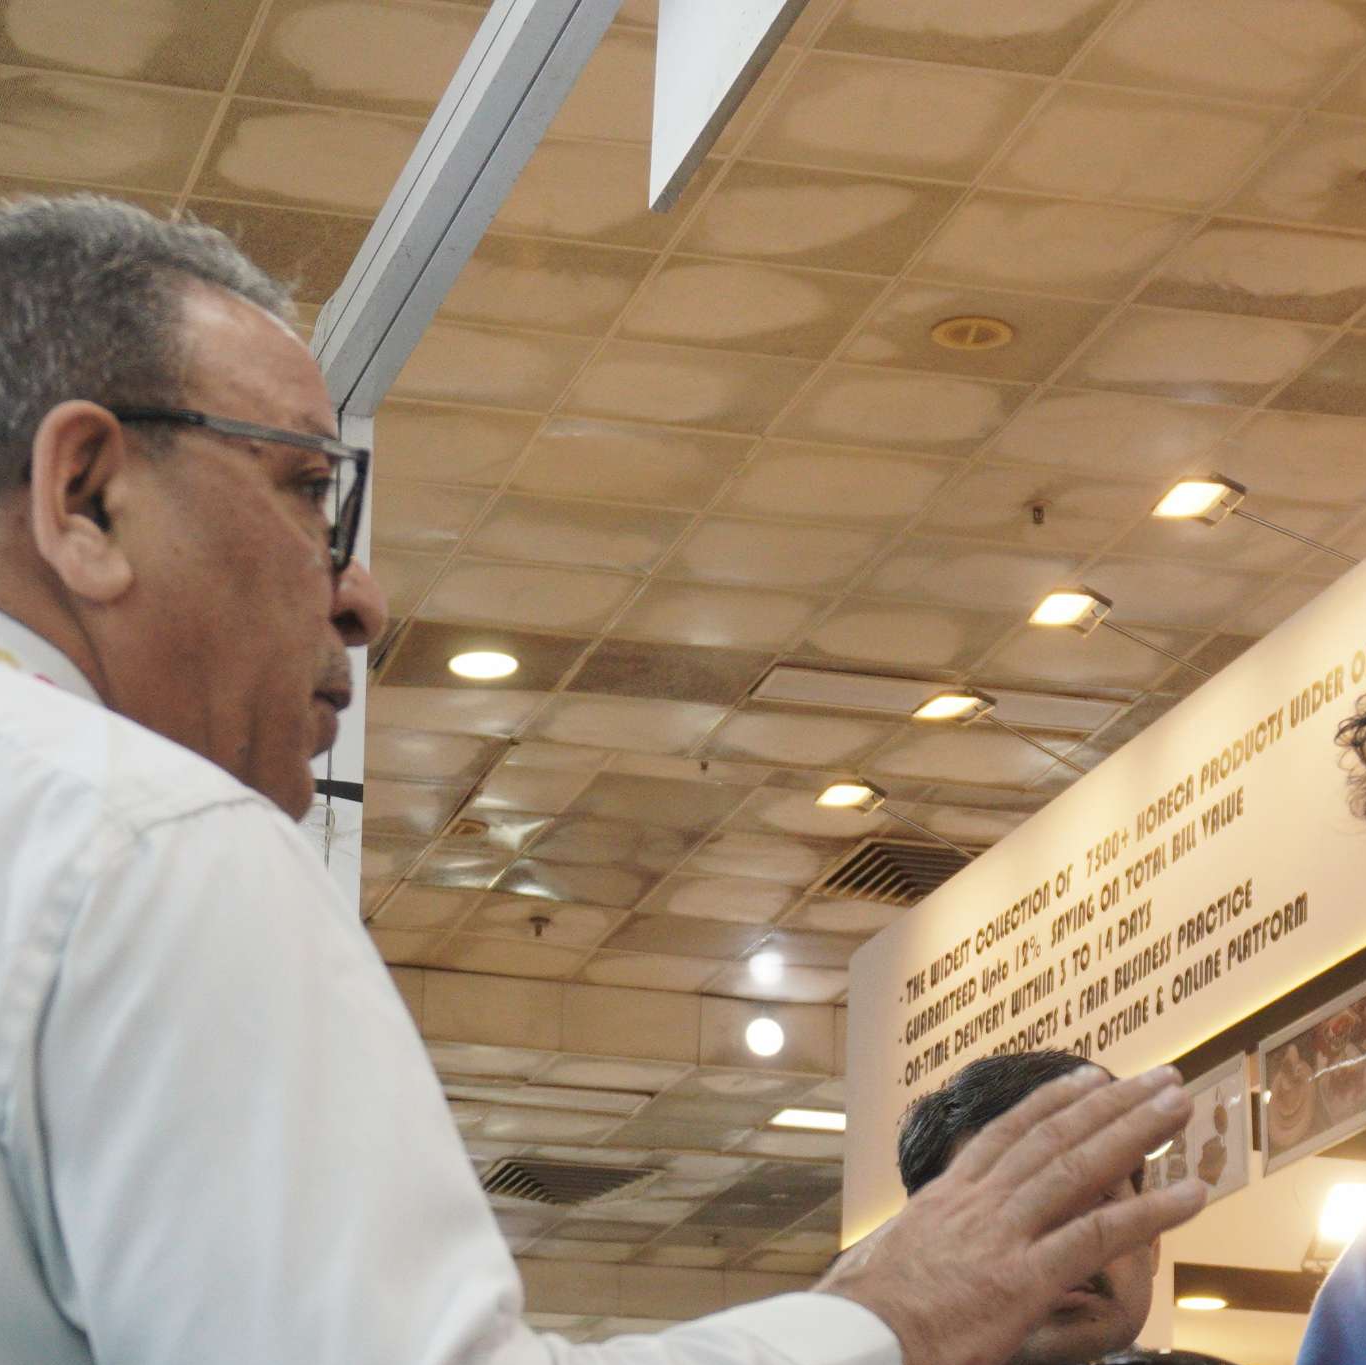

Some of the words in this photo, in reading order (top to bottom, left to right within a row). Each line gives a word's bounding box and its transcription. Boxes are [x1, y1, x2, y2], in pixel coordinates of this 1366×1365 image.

[905, 976, 977, 1045] GUARANTEED
[1051, 893, 1094, 948] SAVING
[1100, 876, 1120, 912] ON
[1125, 842, 1166, 895] TOTAL
[1172, 820, 1196, 864] BILL
[1201, 786, 1244, 839] VALUE
[906, 969, 926, 1004] THE
[930, 937, 971, 989] WIDEST
[975, 879, 1051, 955] COLLECTION
[1055, 864, 1073, 898] OF
[1086, 827, 1129, 878] 7500+
[1137, 773, 1194, 842] HORECA
[1200, 706, 1283, 795] PRODUCTS
[1290, 663, 1344, 728] UNDER
[905, 1036, 950, 1087] ON-TIME
[954, 997, 1006, 1056] DELIVERY
[1011, 966, 1054, 1019] WITHIN
[1072, 942, 1090, 977] TO
[1098, 926, 1113, 961] 14
[1118, 898, 1152, 948] DAYS
[1079, 975, 1109, 1019] FAIR
[1114, 930, 1172, 996] BUSINESS
[1177, 877, 1252, 955] PRACTICE
[1097, 994, 1149, 1052] OFFLINE
[1171, 947, 1221, 1004] ONLINE
[1227, 891, 1308, 971] PLATFORM
